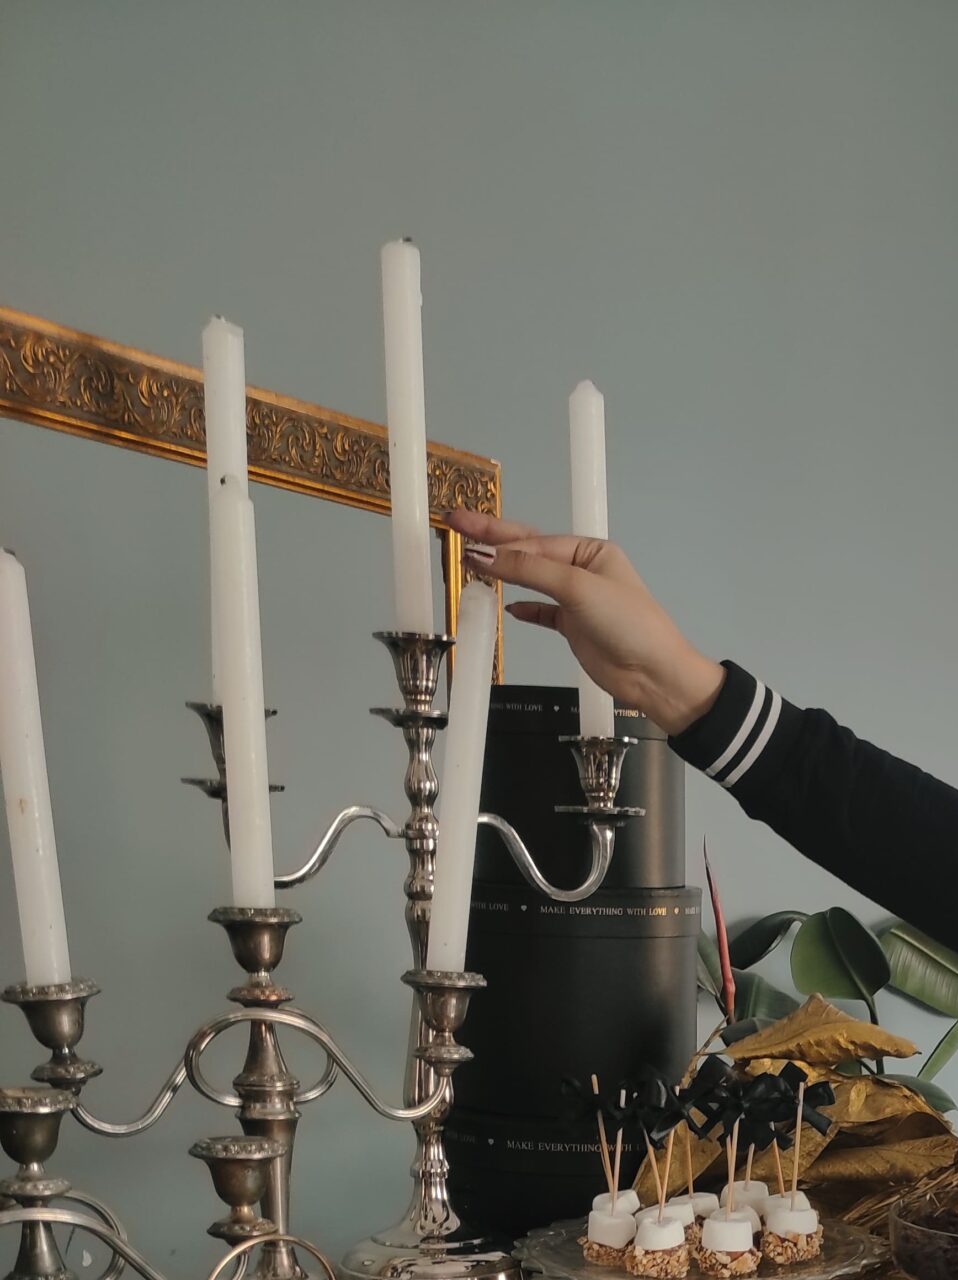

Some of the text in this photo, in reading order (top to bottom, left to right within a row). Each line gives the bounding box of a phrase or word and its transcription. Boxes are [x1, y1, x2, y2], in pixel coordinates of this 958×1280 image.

[523, 703, 543, 712] LOVE
[614, 708, 639, 718] YTHING
[489, 903, 509, 912] LOVE
[540, 905, 566, 914] MAKE
[569, 906, 623, 916] EVERYTHING
[626, 907, 647, 916] WITH
[648, 907, 667, 916] LOVE
[507, 1139, 534, 1151] MAKE
[538, 1142, 601, 1153] EVERYTHING
[608, 1143, 632, 1153] WTH
